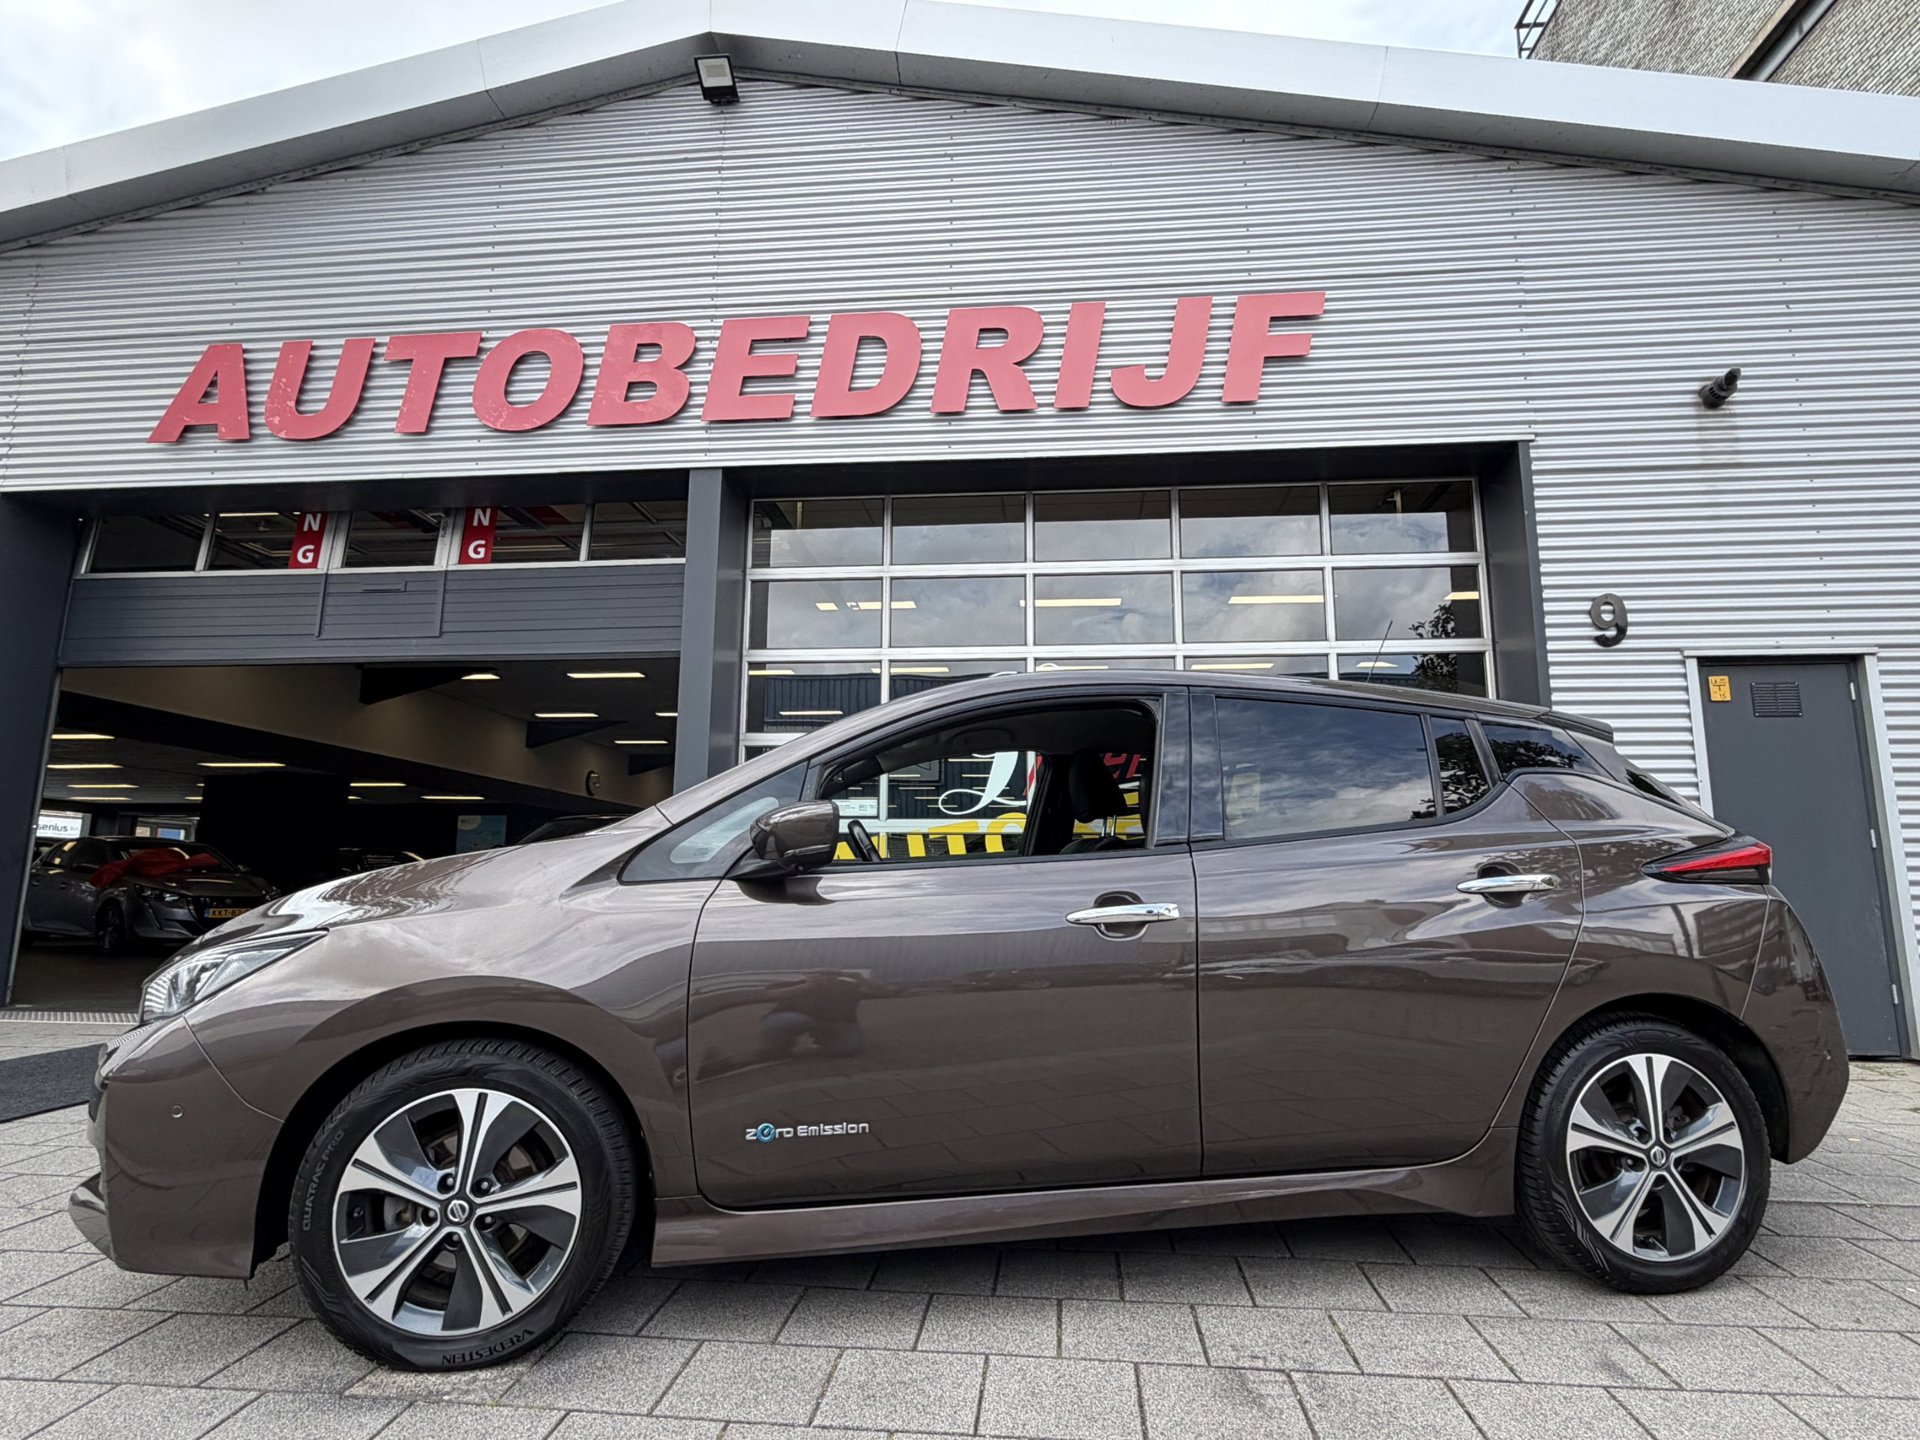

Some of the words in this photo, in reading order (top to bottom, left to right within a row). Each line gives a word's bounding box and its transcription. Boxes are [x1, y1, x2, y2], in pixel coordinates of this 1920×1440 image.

[148, 290, 1327, 444] AUTOBEDRIJF
[1588, 592, 1629, 648] 9
[797, 1122, 870, 1137] Emission
